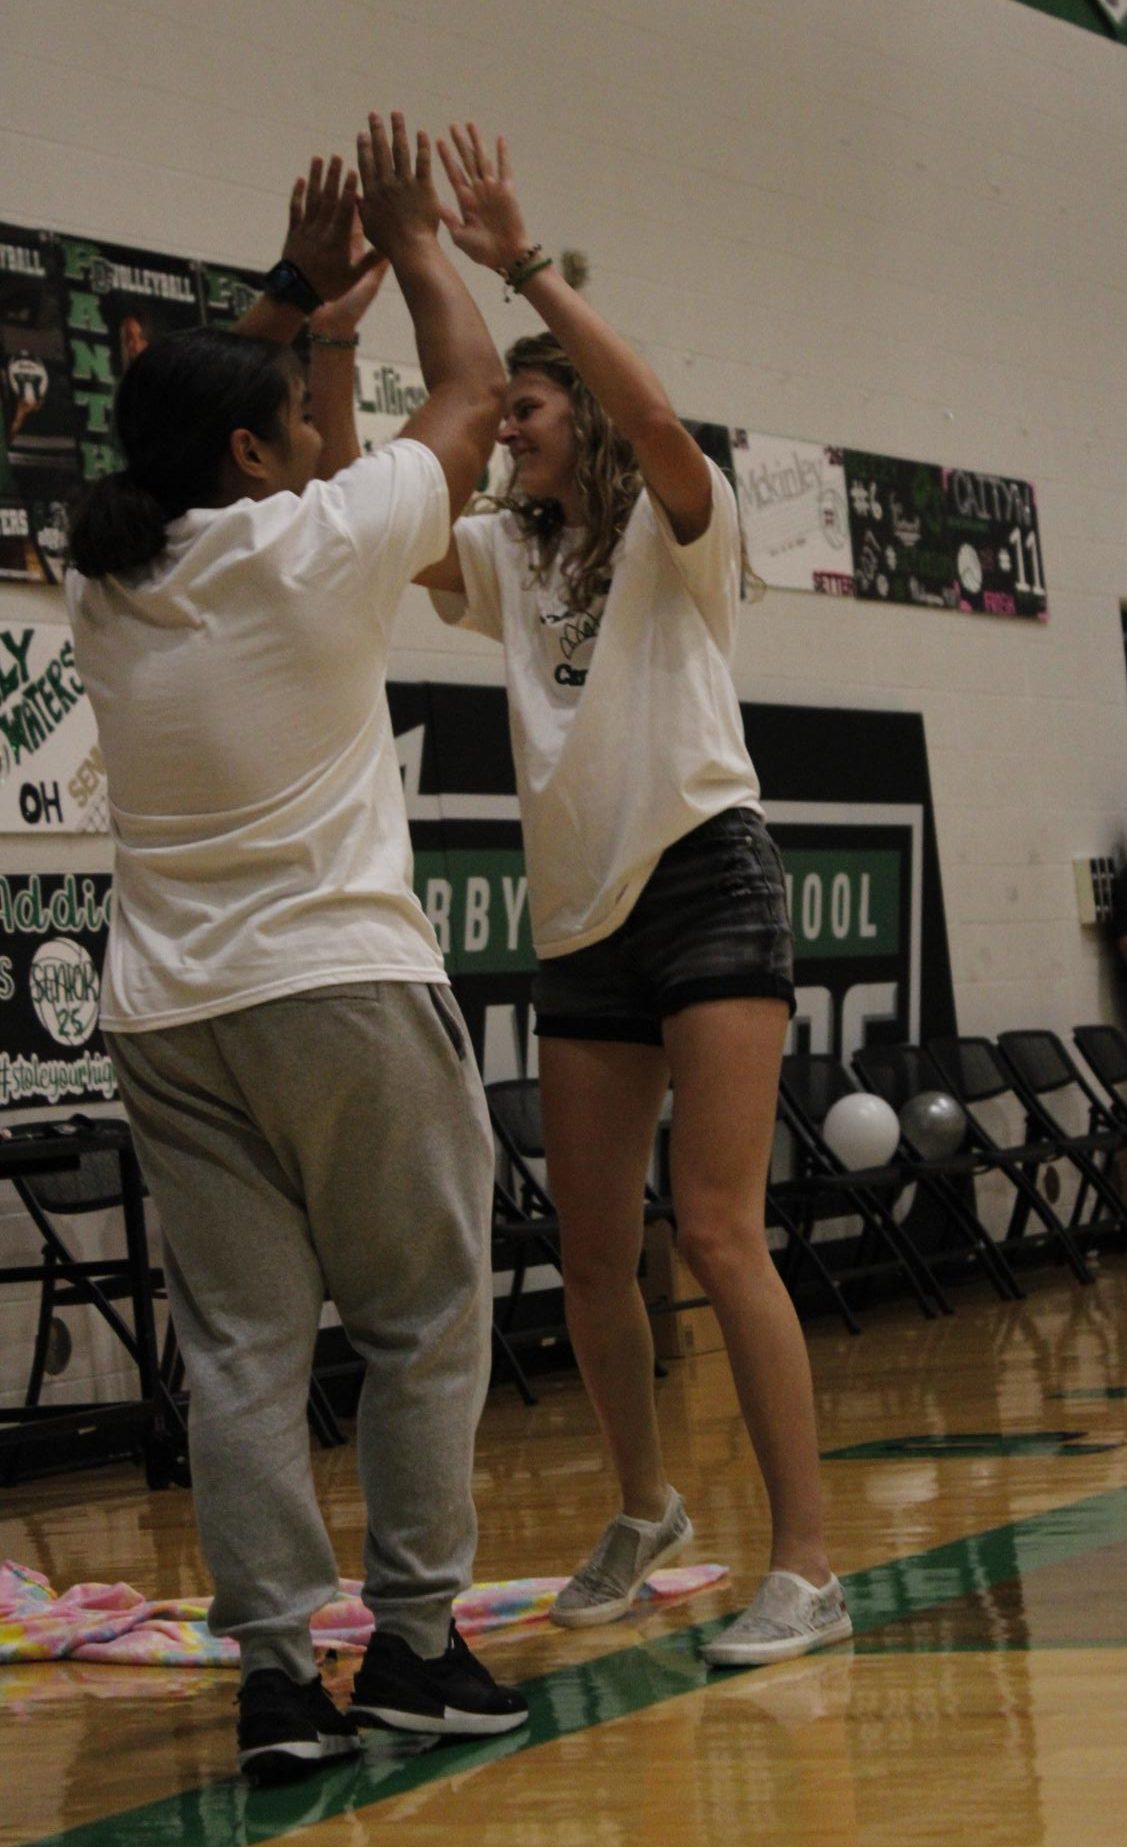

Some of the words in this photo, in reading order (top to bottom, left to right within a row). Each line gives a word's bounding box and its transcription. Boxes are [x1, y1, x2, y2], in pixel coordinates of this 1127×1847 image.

[1007, 526, 1043, 596] 11
[19, 781, 63, 825] OH
[31, 962, 100, 1004] SENIOR
[56, 1008, 85, 1038] 25
